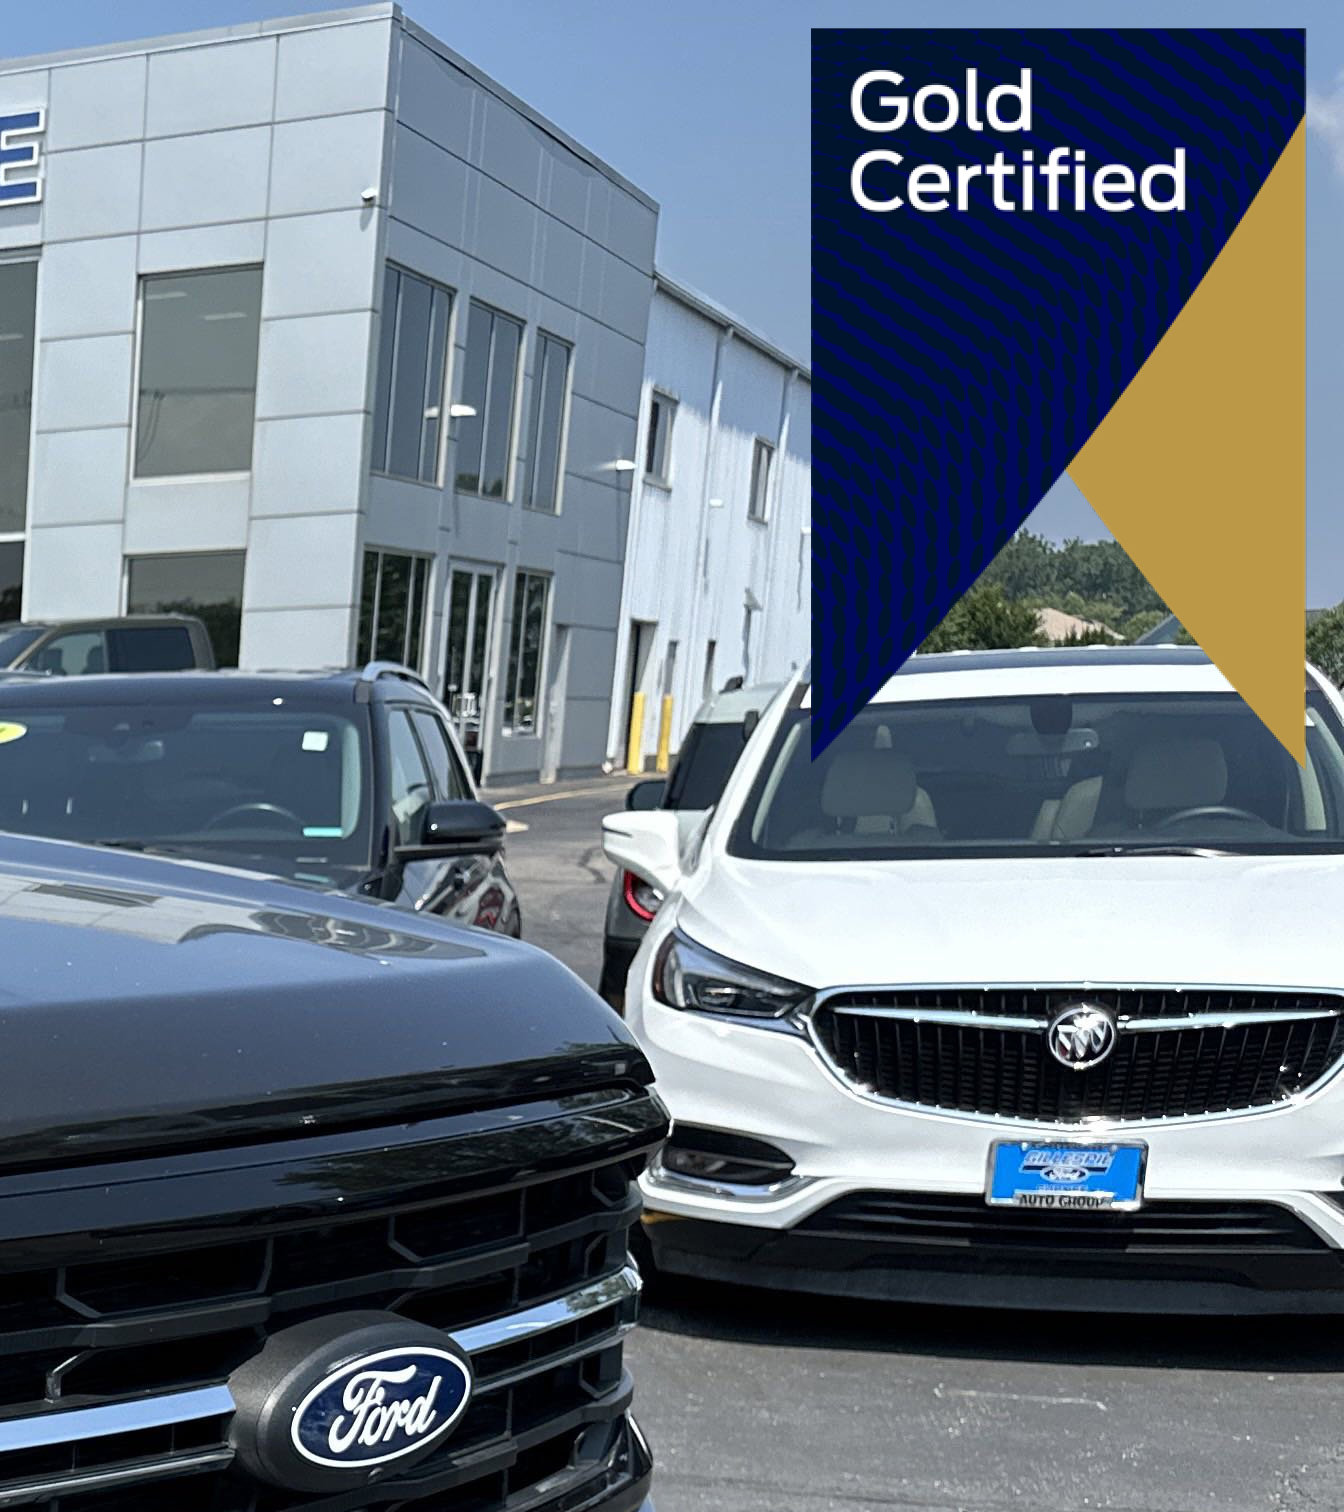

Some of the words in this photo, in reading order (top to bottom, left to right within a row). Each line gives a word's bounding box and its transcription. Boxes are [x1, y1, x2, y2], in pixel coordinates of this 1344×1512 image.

[1020, 1194, 1055, 1206] AUTO
[1059, 1195, 1106, 1209] GROUP
[328, 1364, 443, 1453] Ford
